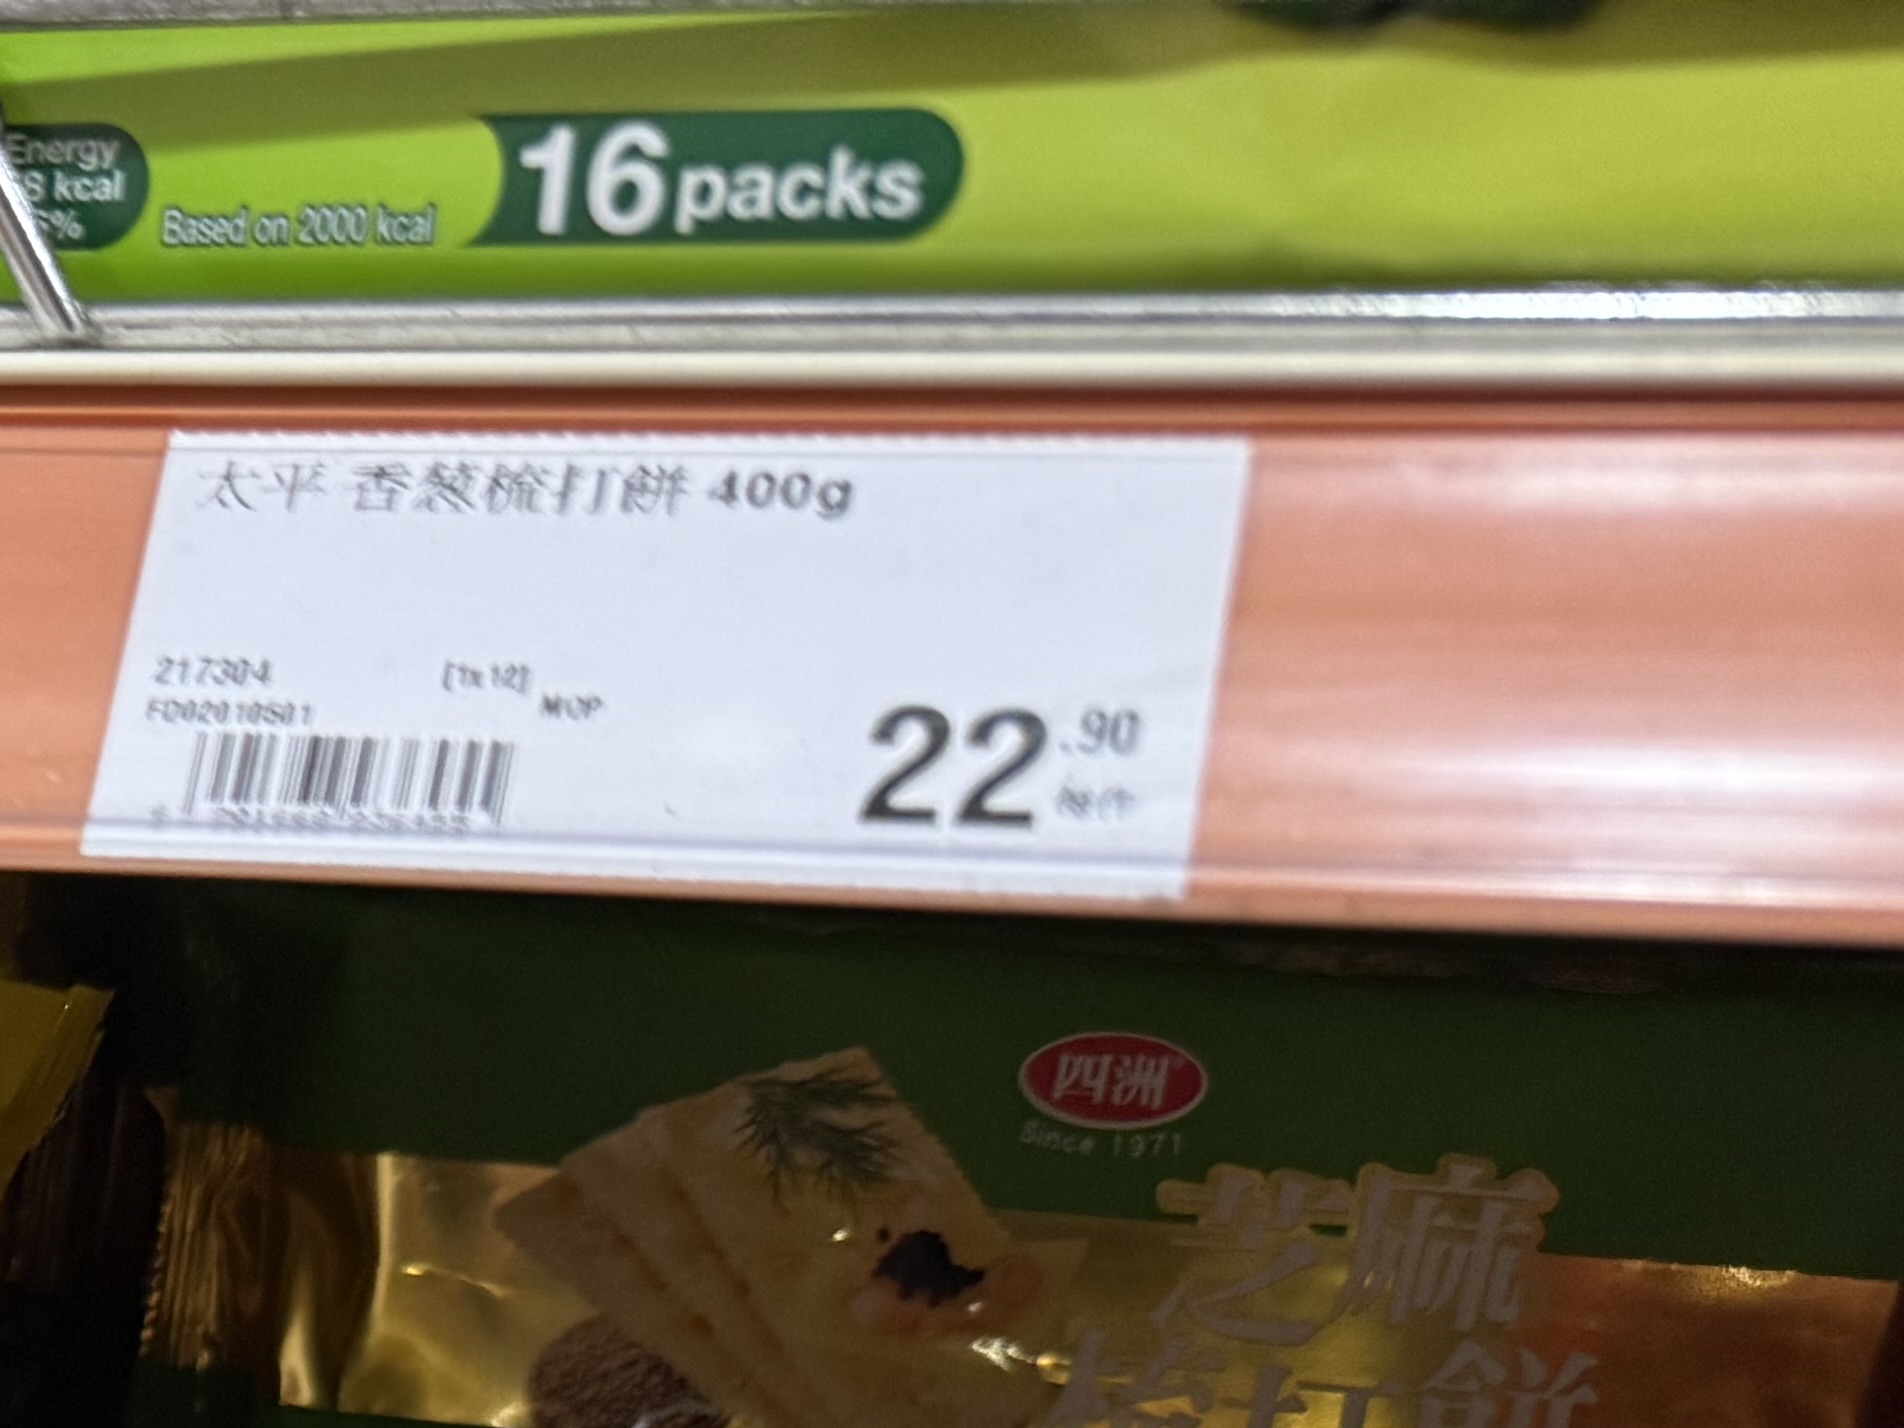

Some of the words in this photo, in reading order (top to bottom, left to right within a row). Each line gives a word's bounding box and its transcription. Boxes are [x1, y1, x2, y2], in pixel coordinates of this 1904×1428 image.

[54, 171, 128, 202] kcal
[519, 121, 670, 238] 16
[673, 149, 924, 237] packs
[161, 207, 251, 249] Based
[254, 214, 289, 247] on
[296, 204, 368, 247] 2000
[374, 203, 437, 247] kcal
[199, 461, 329, 514] 太平
[709, 467, 853, 519] 400g
[855, 703, 1050, 830] 22
[1050, 1049, 1171, 1110] 四洲
[1150, 1160, 1550, 1348] 芝麻
